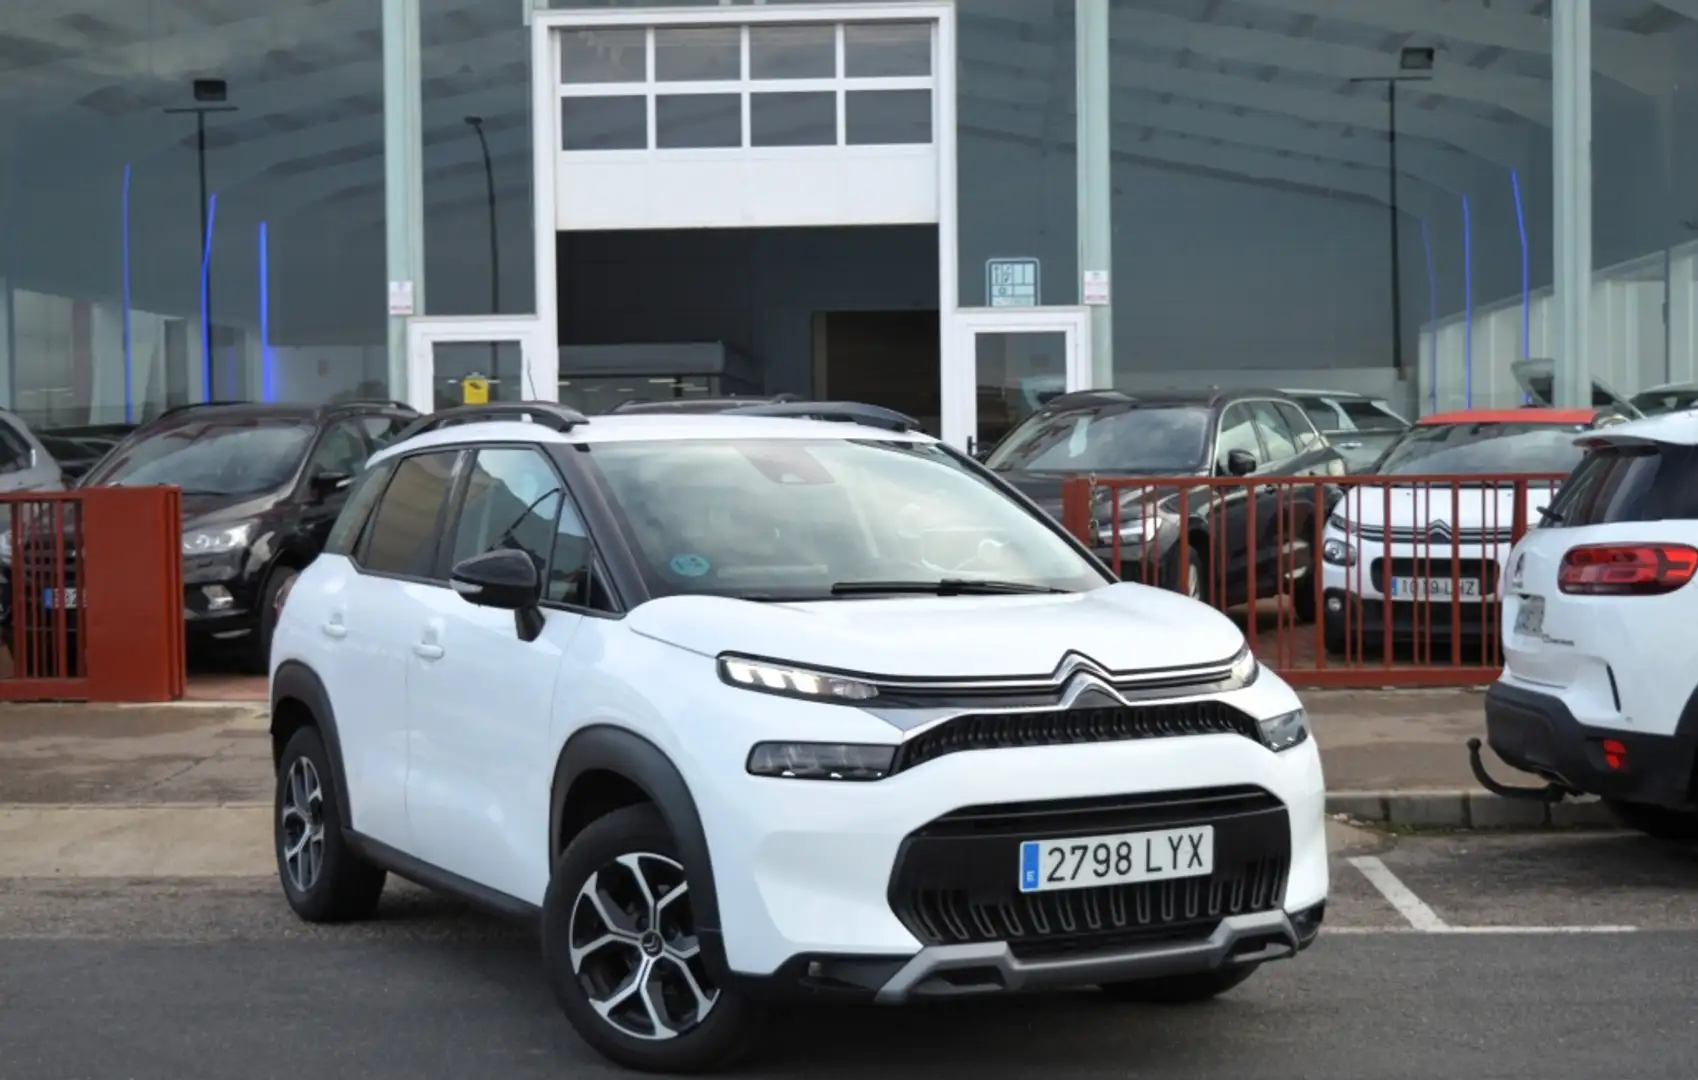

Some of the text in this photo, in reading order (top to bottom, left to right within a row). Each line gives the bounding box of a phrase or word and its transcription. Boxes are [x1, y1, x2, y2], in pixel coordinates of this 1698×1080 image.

[1047, 833, 1204, 882] 2798 LYX
[1026, 870, 1035, 882] E
